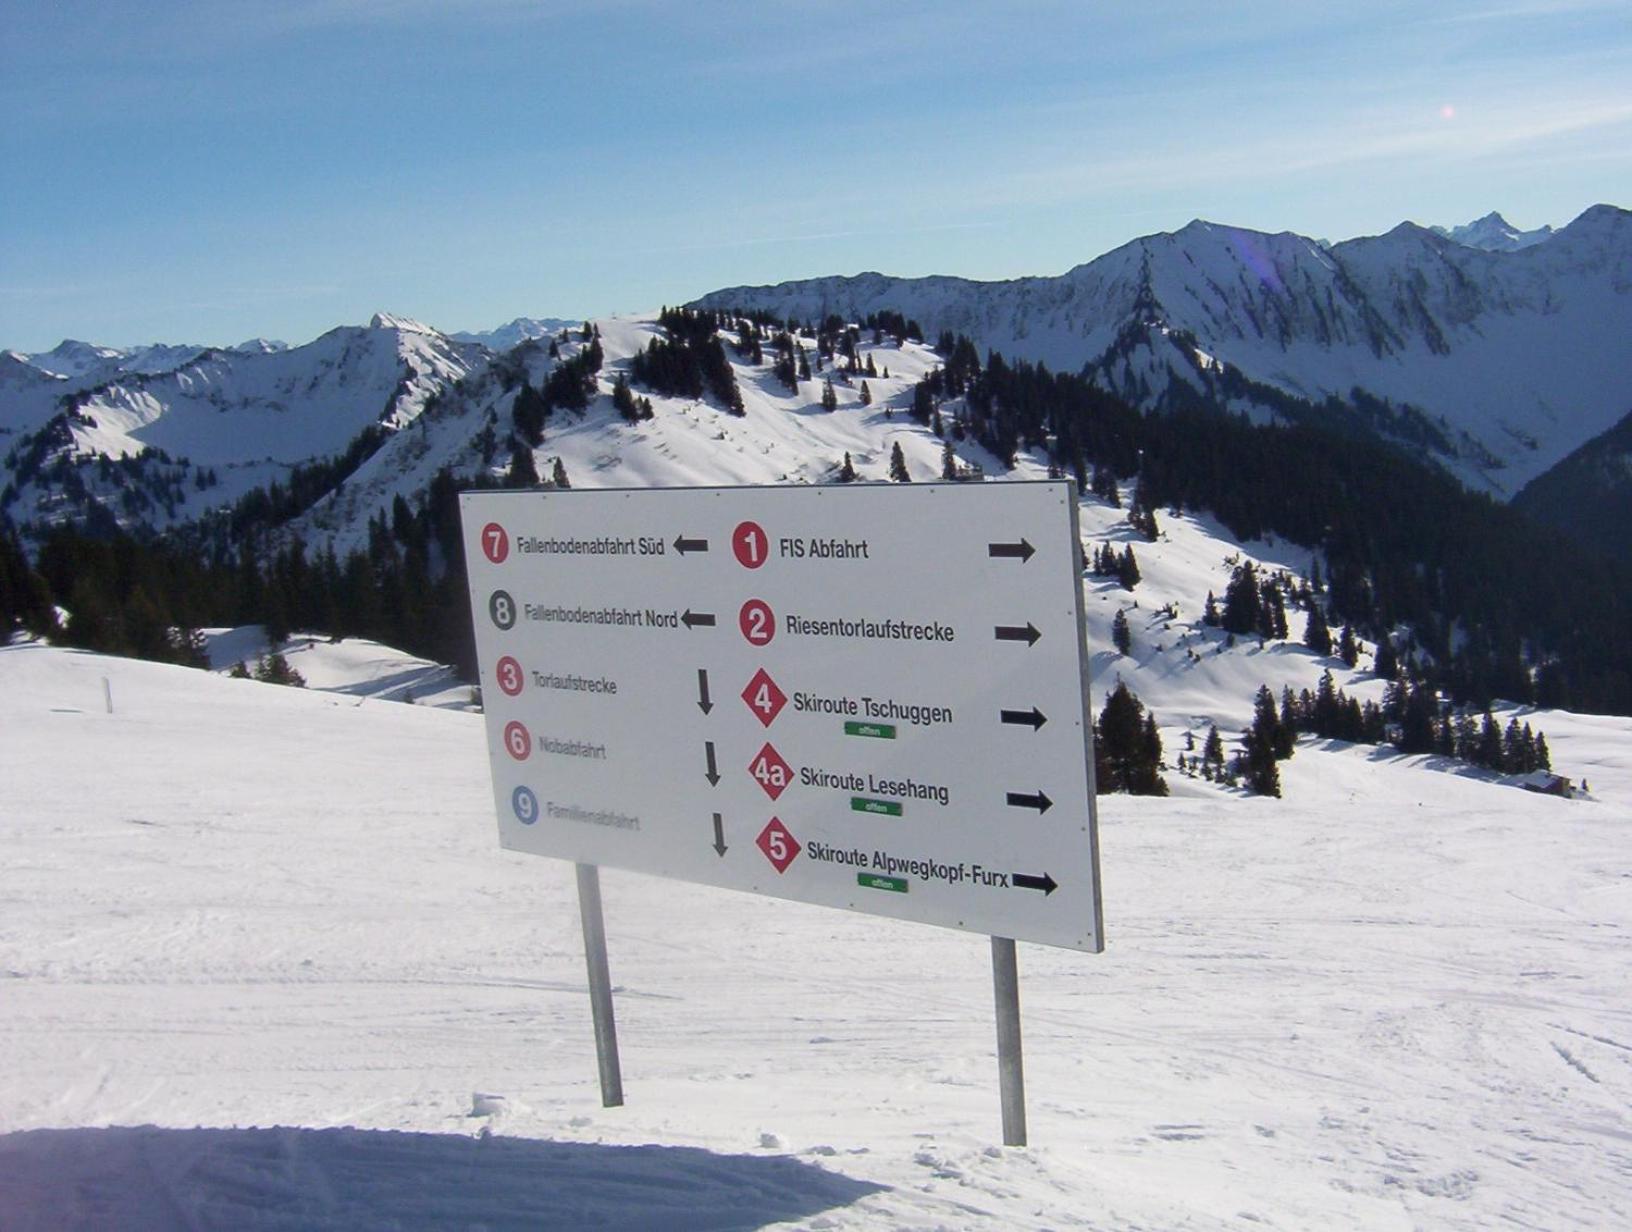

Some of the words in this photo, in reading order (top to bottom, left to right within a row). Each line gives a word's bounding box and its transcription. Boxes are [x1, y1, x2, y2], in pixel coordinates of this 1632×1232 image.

[488, 531, 501, 558] 7
[517, 537, 636, 555] Fallenbodenabfahrt
[639, 537, 665, 555] Süd
[745, 531, 758, 562] 1
[780, 539, 805, 558] FIS
[809, 539, 869, 559] Abfahrt
[496, 597, 511, 624] 8
[525, 604, 642, 626] Fallenbodenabfahrt
[646, 610, 678, 628] Nord
[749, 607, 767, 639] 2
[787, 615, 954, 641] Riesentorlaufstrecke
[503, 663, 517, 690] 3
[532, 671, 617, 694] Torlaufstrecke
[755, 684, 772, 714] 4
[794, 692, 857, 716] Skiroute
[862, 697, 953, 726] Tschuggen
[511, 728, 524, 754] 6
[755, 757, 785, 787] 4a
[801, 767, 864, 792] Skiroute
[869, 774, 949, 806] Lesehang
[518, 793, 532, 818] 9
[770, 831, 787, 860] 5
[807, 841, 868, 867] Skiroute
[873, 851, 1009, 888] Alpwegkopf-Furx
